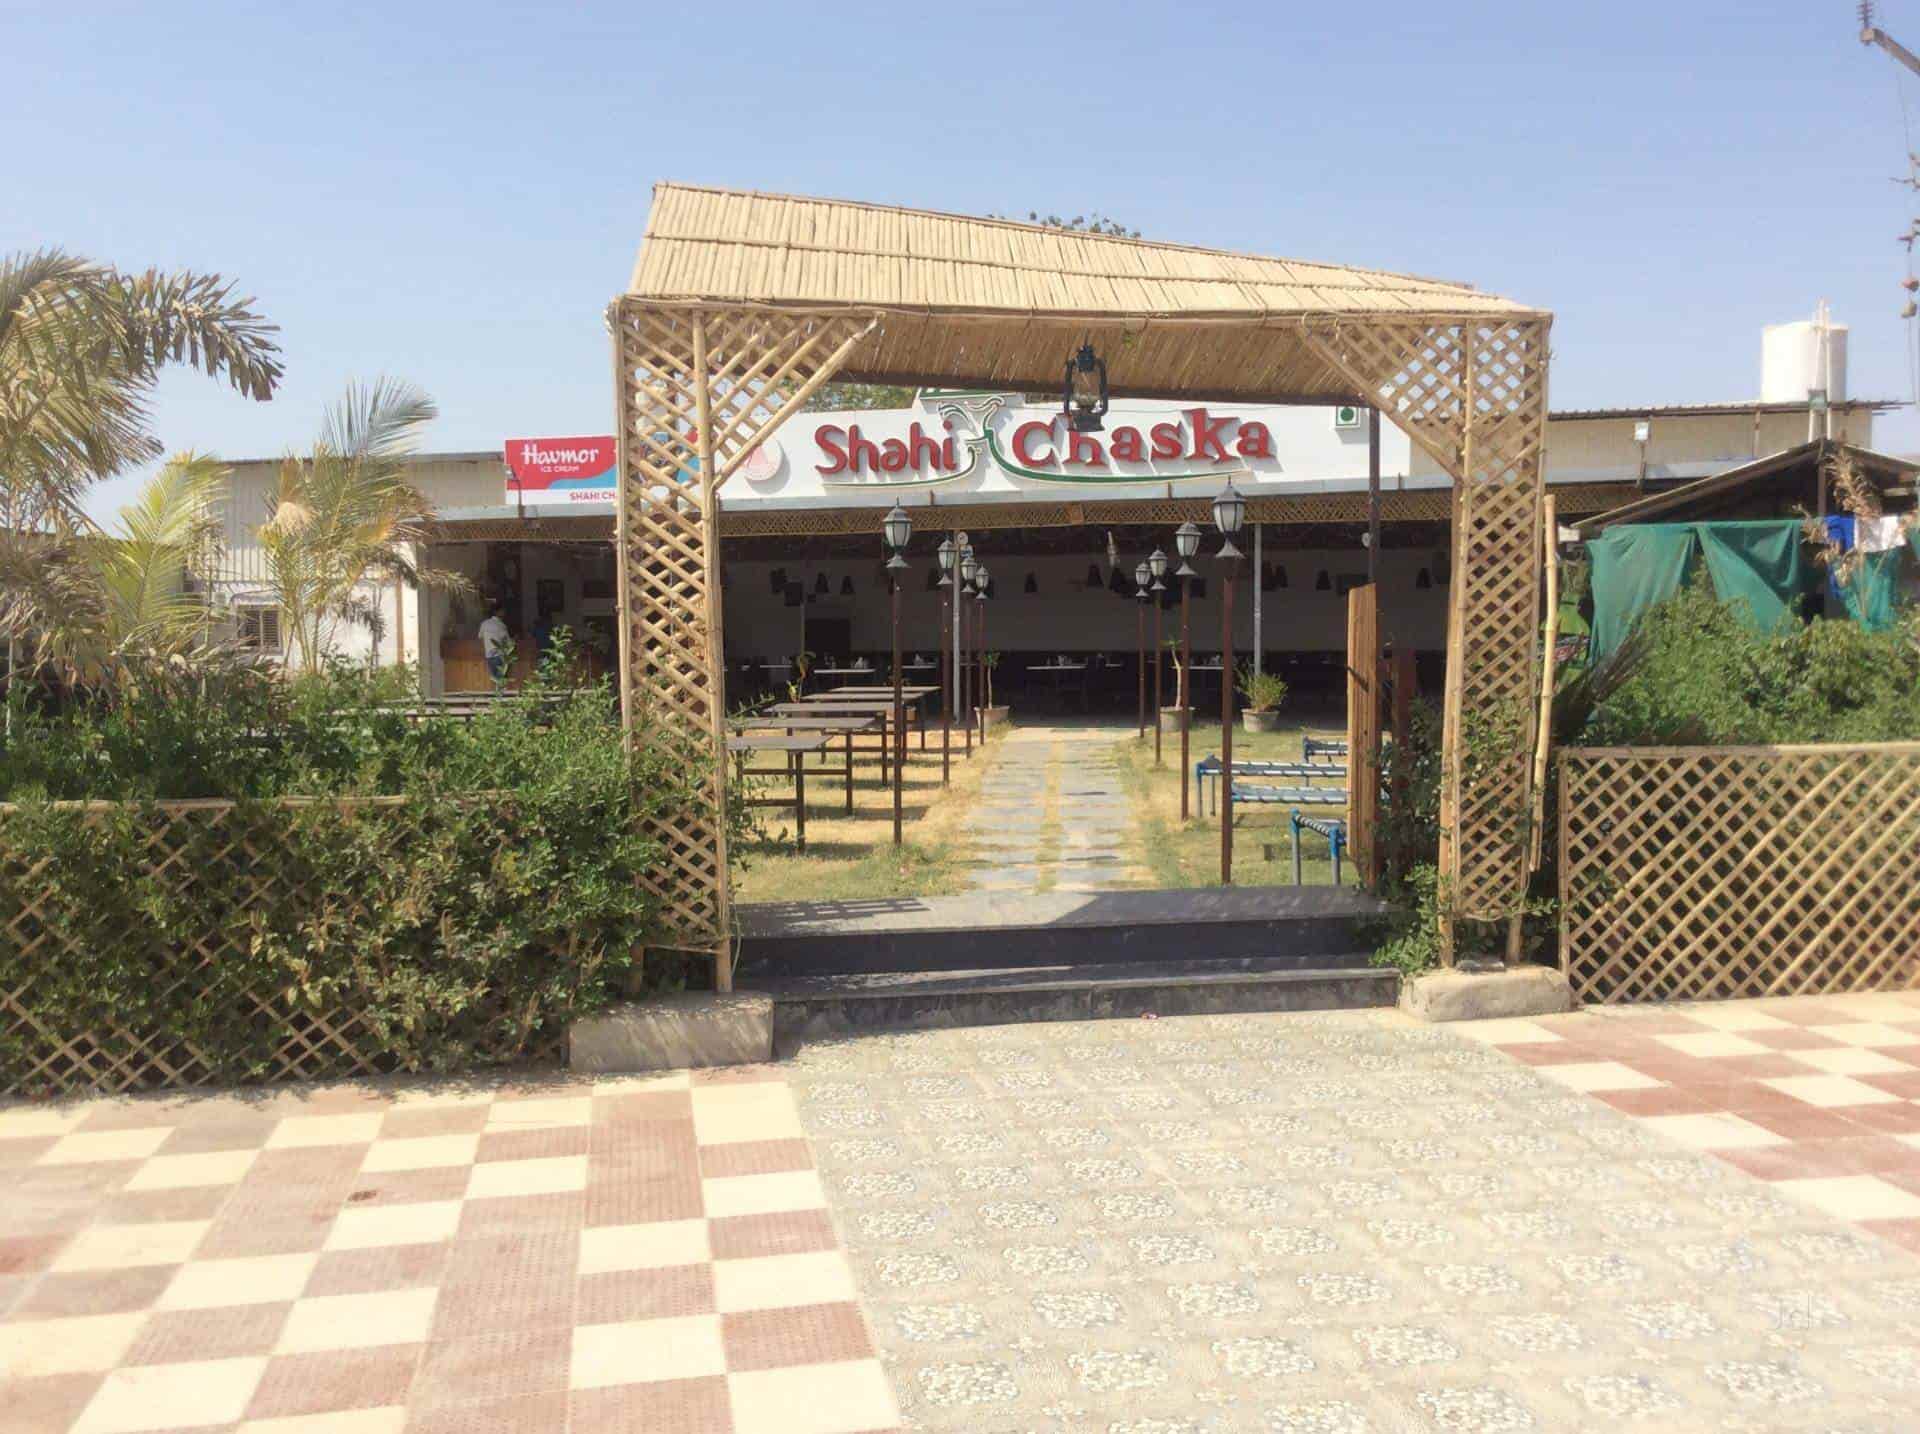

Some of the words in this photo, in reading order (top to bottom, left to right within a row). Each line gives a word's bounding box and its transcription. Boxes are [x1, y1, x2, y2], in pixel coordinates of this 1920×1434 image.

[815, 419, 958, 475] Shahi
[1011, 407, 1276, 468] Chaska
[520, 443, 600, 465] Havmor
[541, 465, 553, 473] ICE
[554, 464, 580, 473] CREAM
[569, 491, 599, 501] SHAHI
[600, 490, 617, 500] CH
